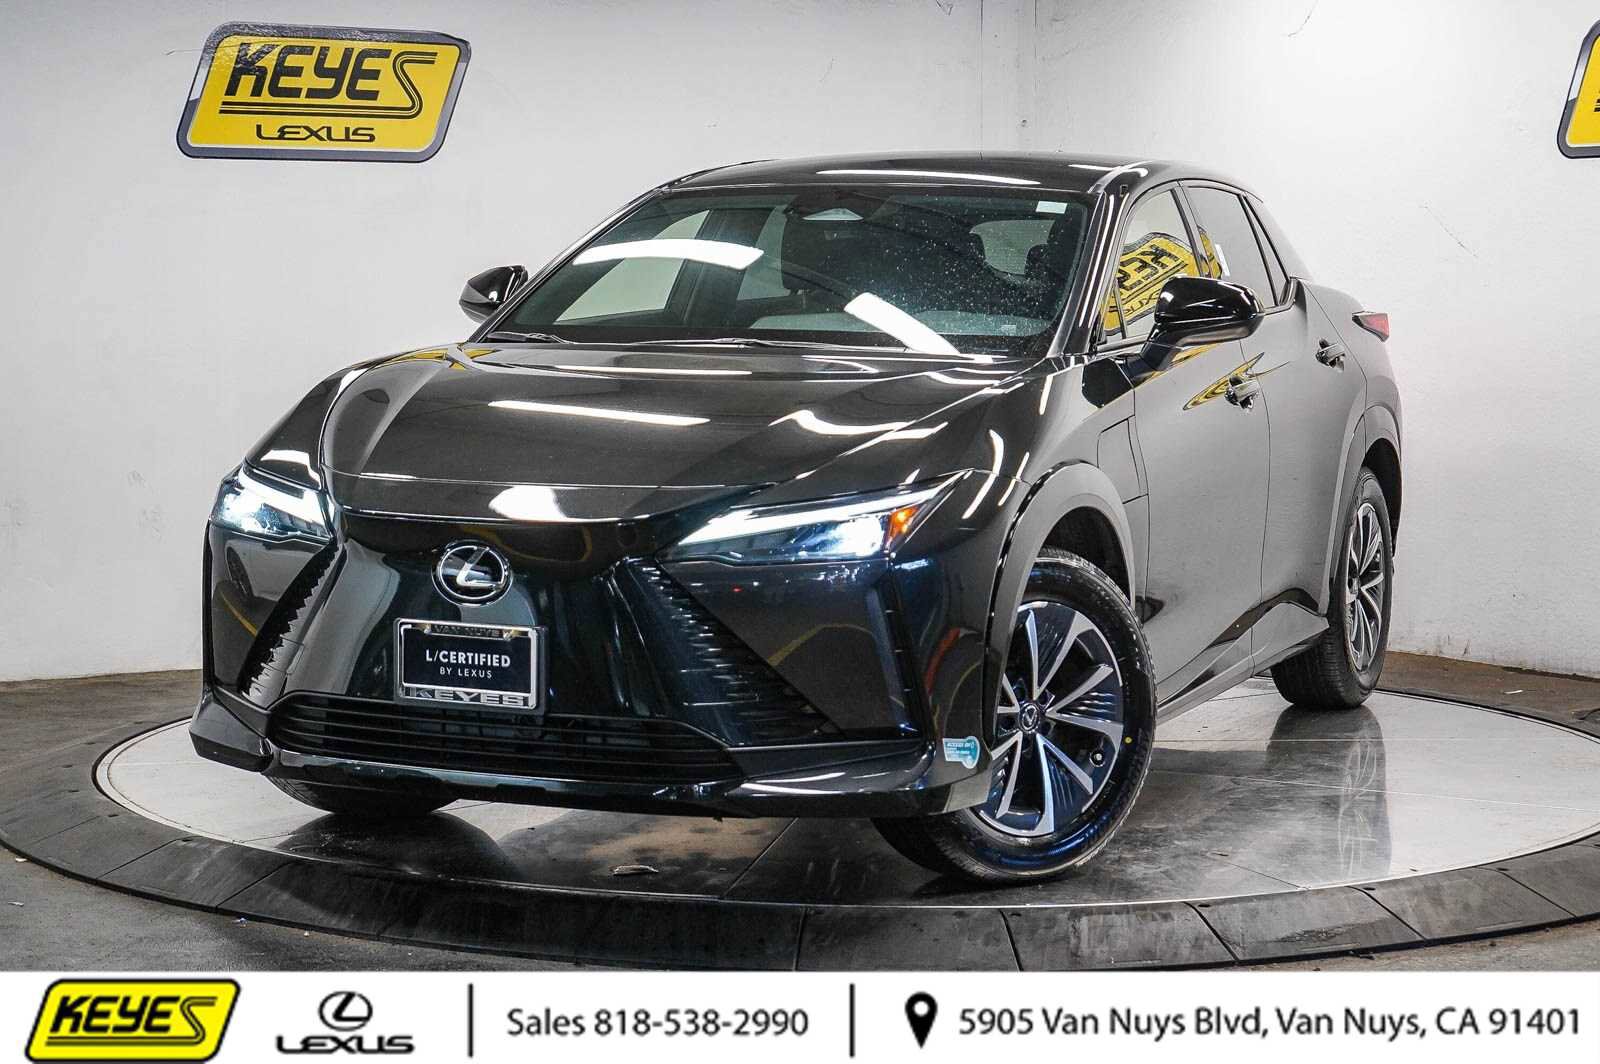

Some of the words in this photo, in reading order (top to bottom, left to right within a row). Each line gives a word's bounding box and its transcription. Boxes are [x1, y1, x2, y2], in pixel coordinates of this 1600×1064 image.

[220, 42, 438, 118] KEYES
[255, 123, 376, 143] LEXUS
[425, 649, 511, 668] L/CERTIFIED
[439, 666, 453, 676] BY
[457, 667, 493, 679] LEXUS
[409, 686, 524, 706] KEYES
